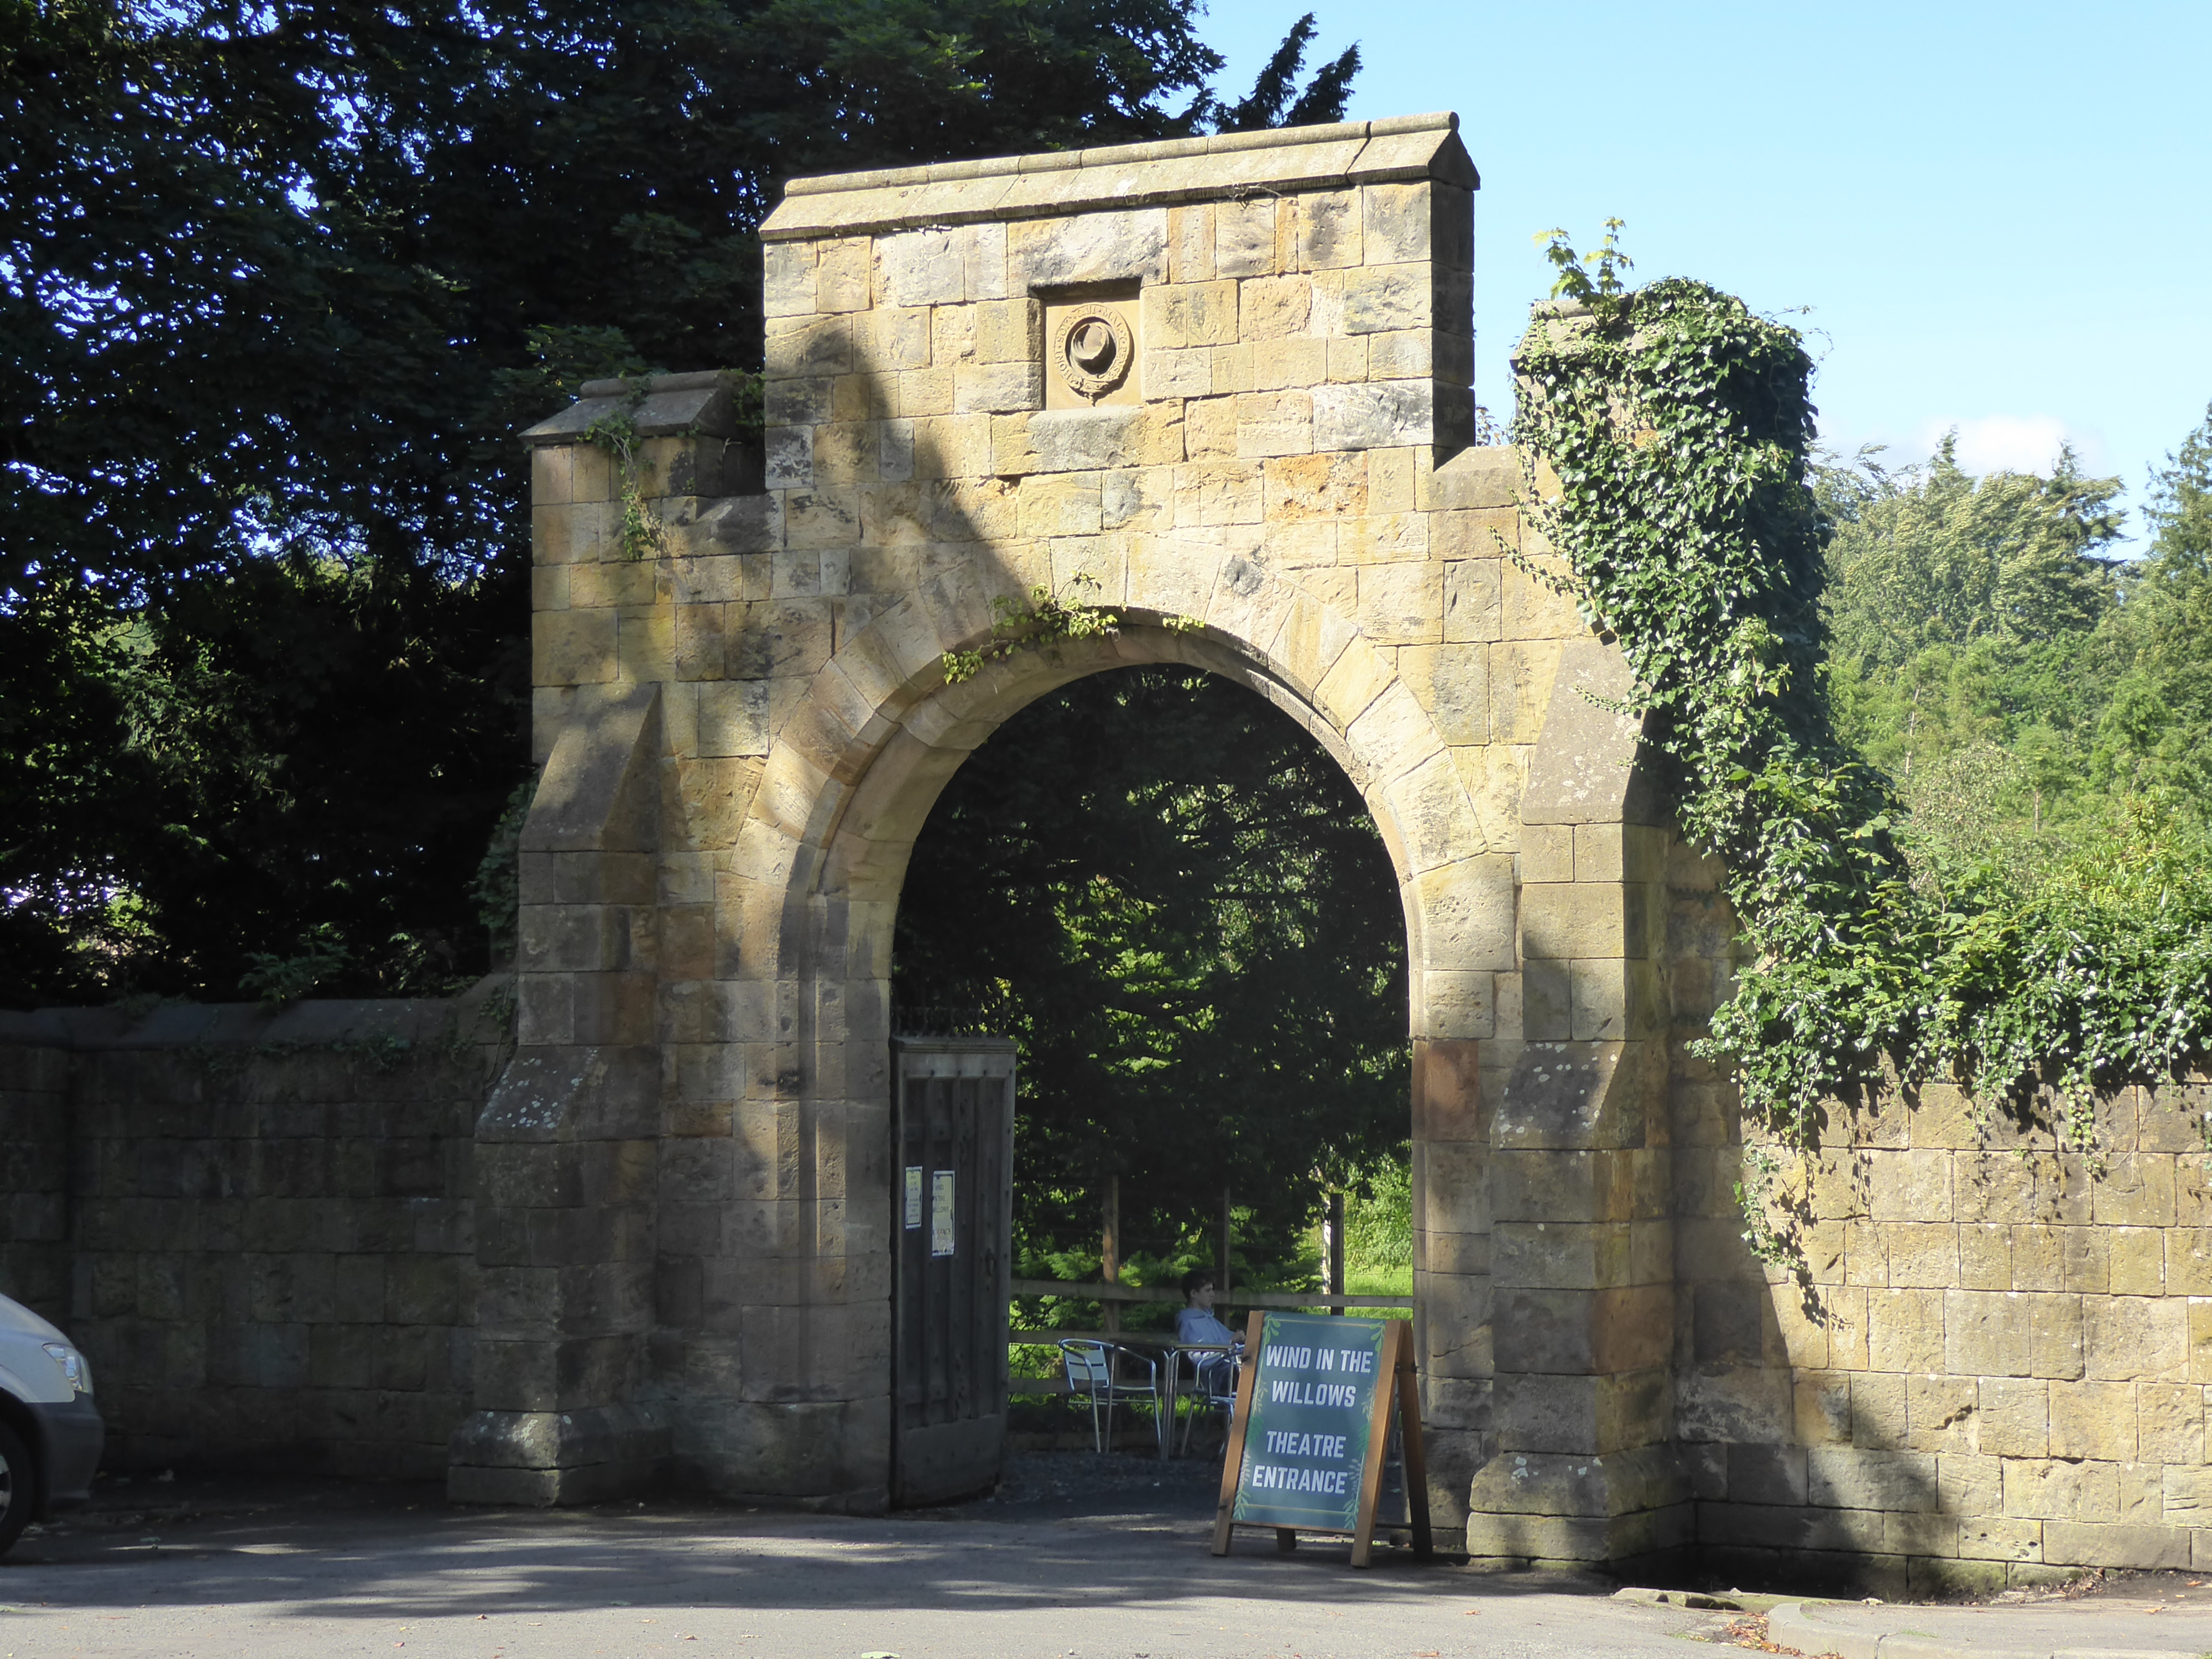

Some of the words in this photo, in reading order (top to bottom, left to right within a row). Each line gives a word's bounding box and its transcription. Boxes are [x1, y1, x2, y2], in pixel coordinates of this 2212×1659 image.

[1266, 1345, 1311, 1369] WIND
[1316, 1348, 1334, 1370] IN
[1340, 1349, 1374, 1373] THE
[1272, 1380, 1356, 1407] WILLOWS
[1267, 1431, 1347, 1458] THEATRE
[1252, 1465, 1348, 1494] ENTRANCE
